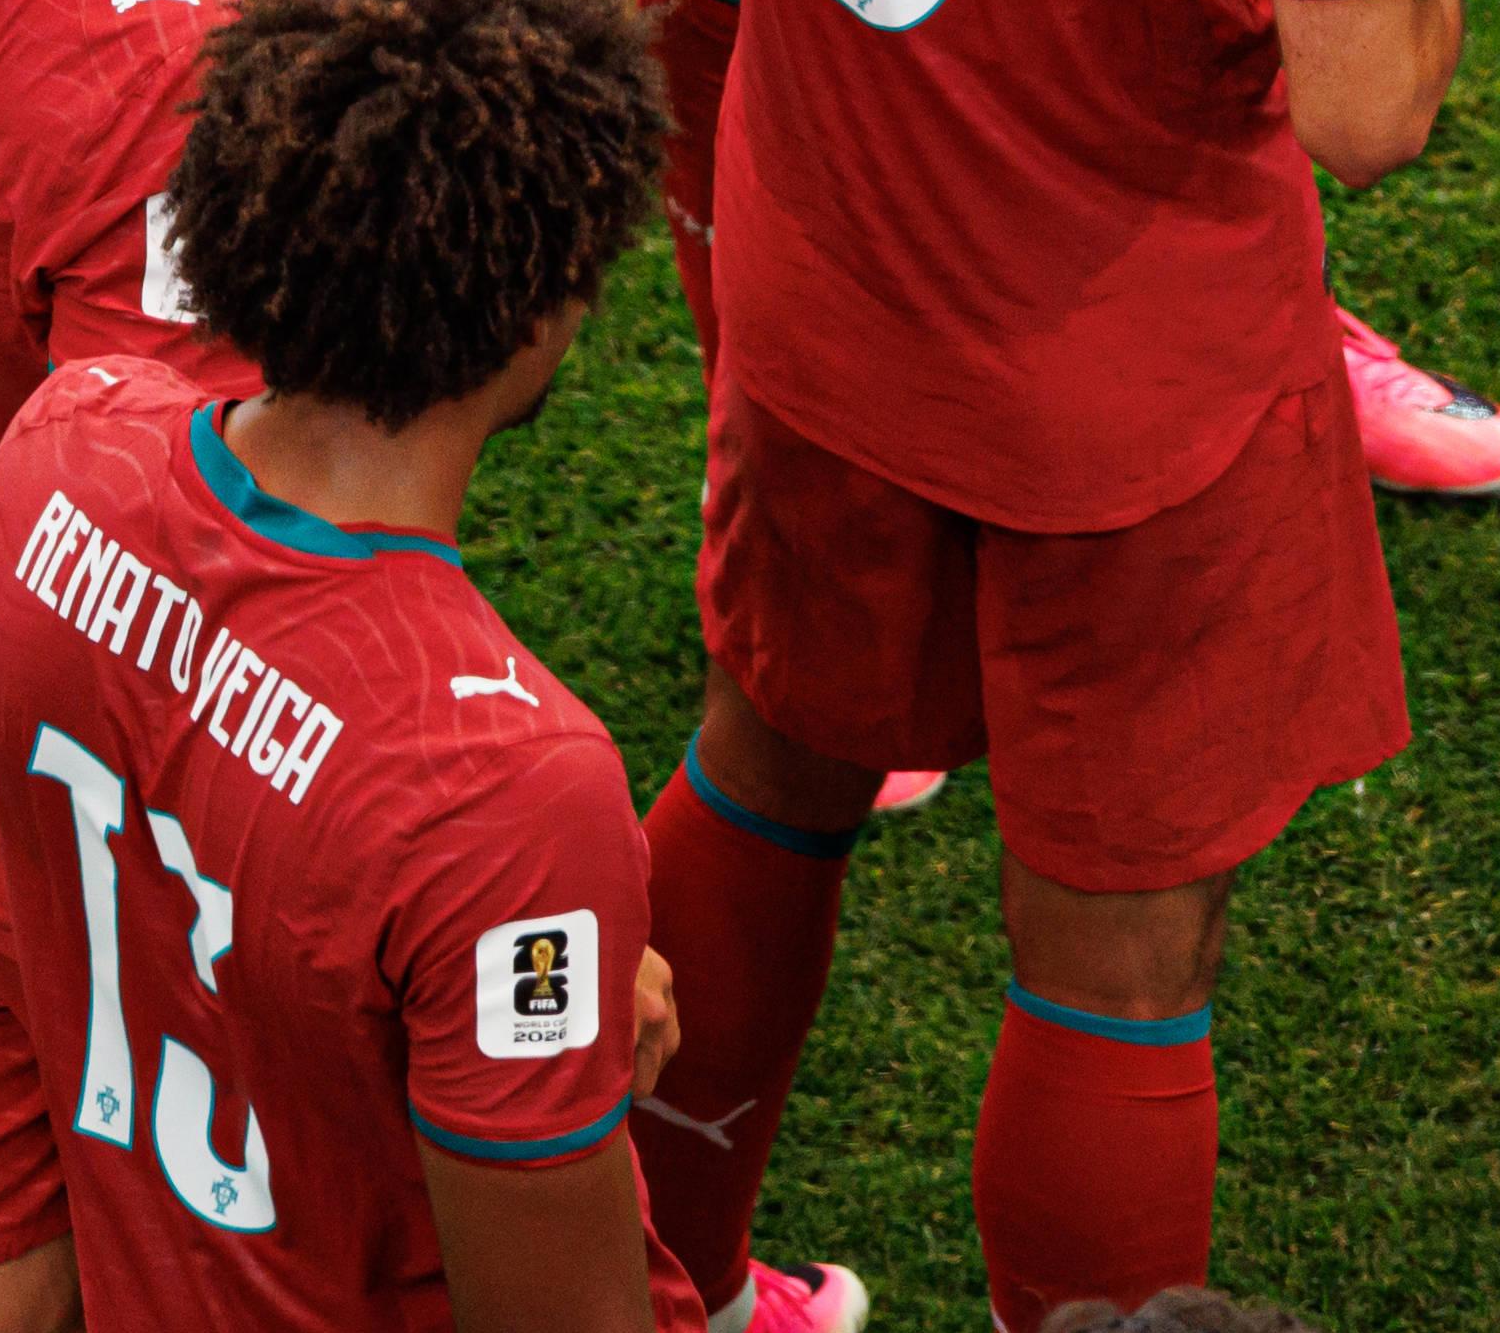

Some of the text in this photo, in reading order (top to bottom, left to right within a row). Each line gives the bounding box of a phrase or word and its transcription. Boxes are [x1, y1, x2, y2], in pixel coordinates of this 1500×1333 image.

[14, 489, 345, 806] RENATO VEIGA
[26, 721, 278, 1235] 13
[528, 998, 558, 1012] FIFA
[513, 1017, 568, 1029] WORLD CU
[513, 1028, 568, 1043] 2026
